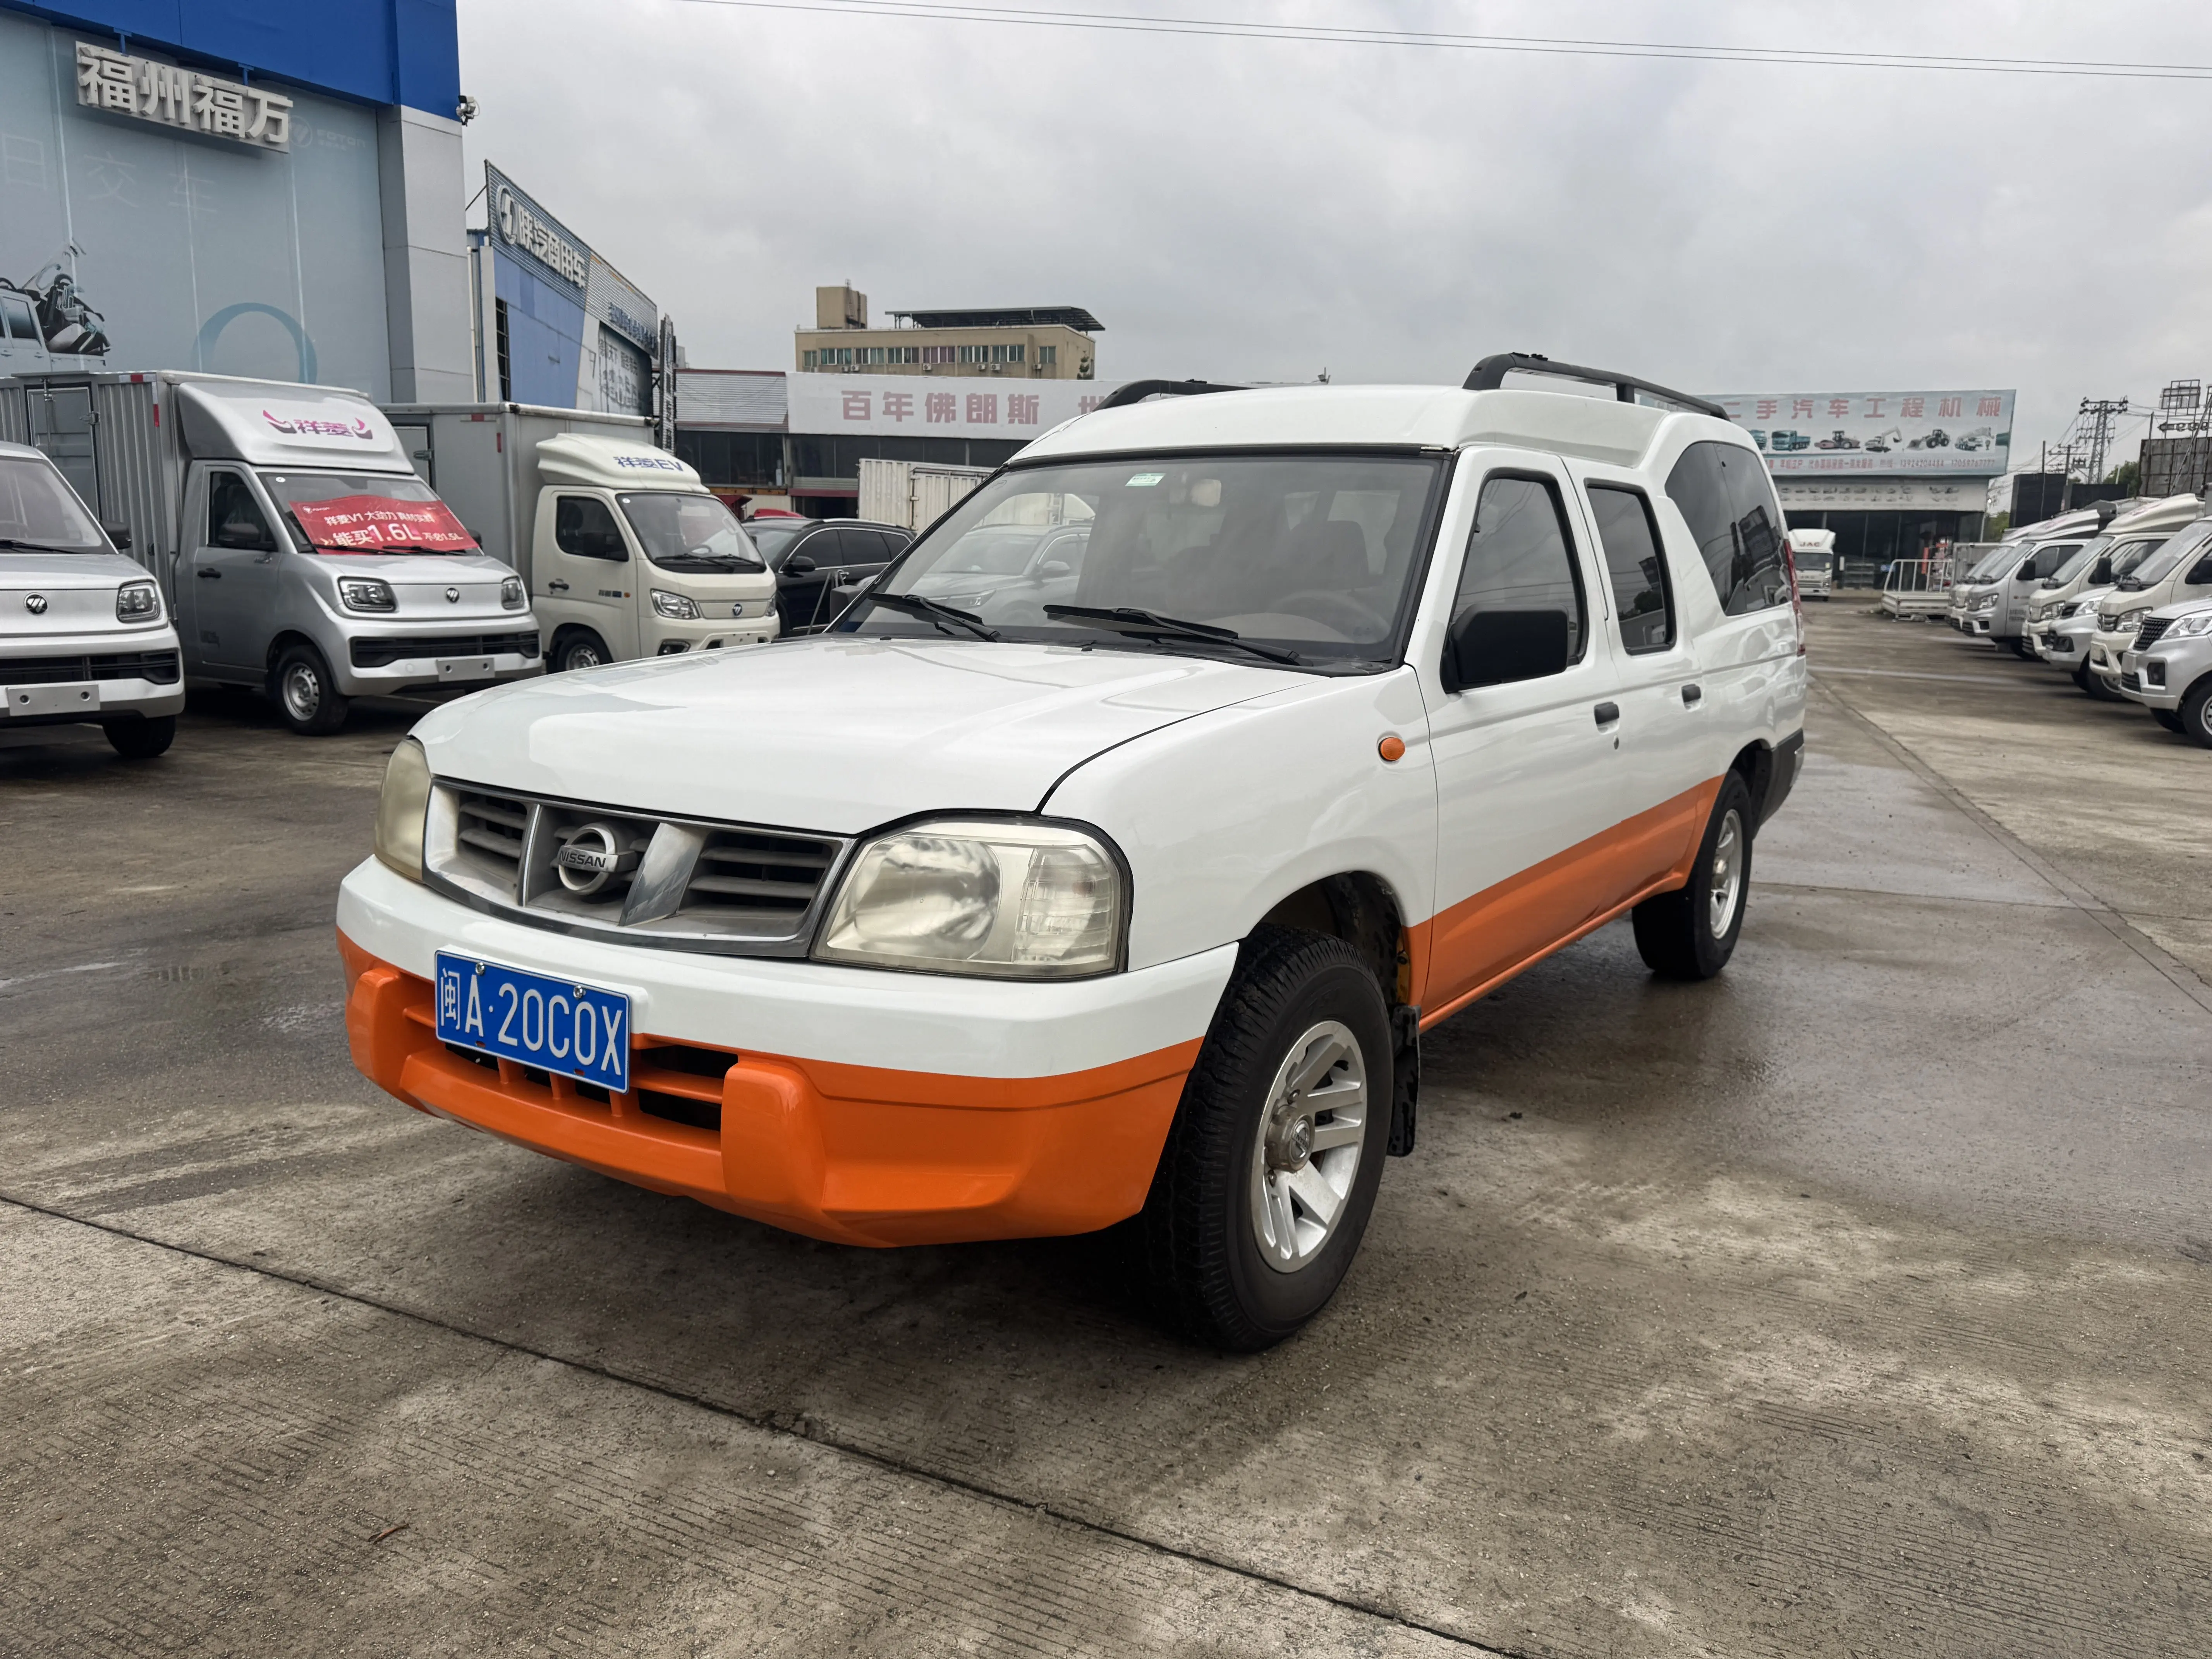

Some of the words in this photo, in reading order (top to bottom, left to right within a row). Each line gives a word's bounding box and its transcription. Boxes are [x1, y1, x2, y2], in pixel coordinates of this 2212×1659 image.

[77, 44, 293, 143] 福州福万
[519, 204, 586, 288] 陕汽商用车
[841, 390, 1039, 425] 百年佛朗斯
[293, 419, 354, 437] 祥菱
[559, 850, 606, 868] NISSAN
